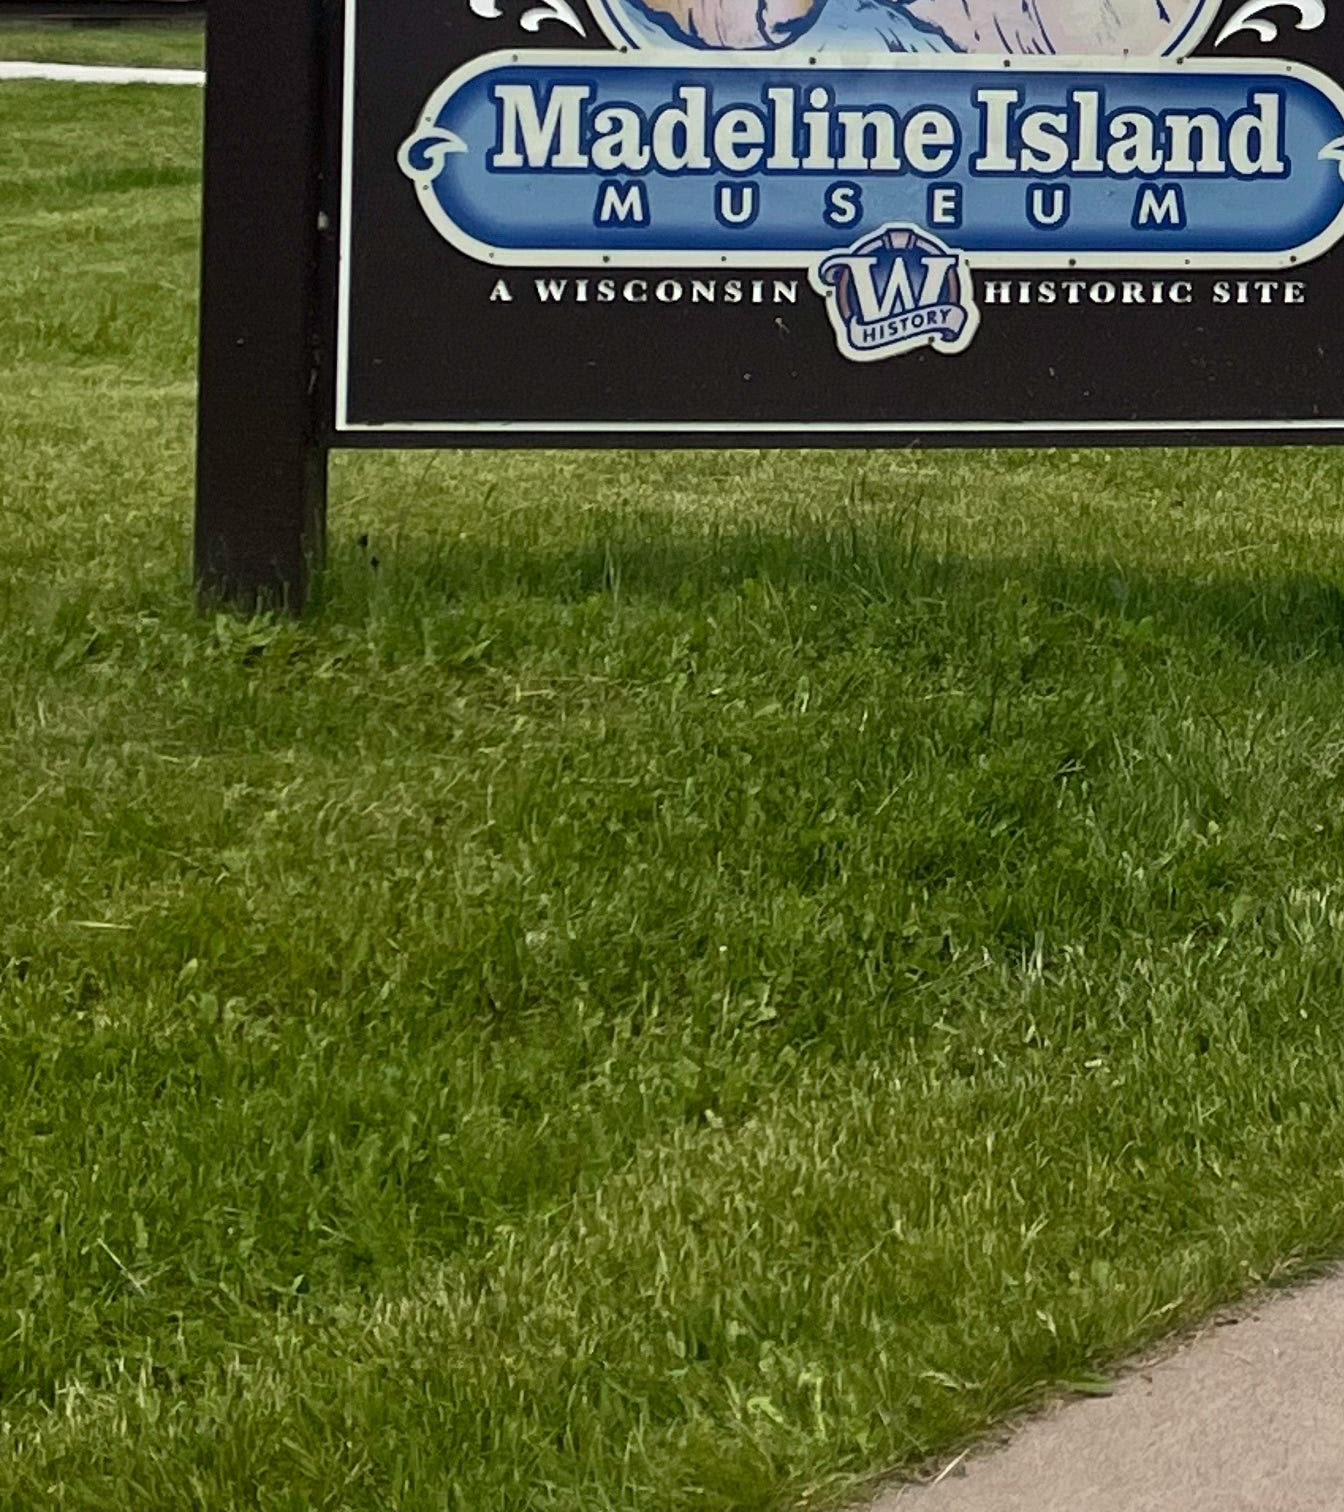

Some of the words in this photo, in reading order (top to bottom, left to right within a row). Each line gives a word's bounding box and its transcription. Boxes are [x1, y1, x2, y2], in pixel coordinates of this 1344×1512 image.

[492, 84, 955, 171] Madeline
[975, 89, 1285, 175] Island
[600, 185, 1180, 225] MUSEUM
[489, 279, 513, 302] A
[534, 279, 798, 303] WISCONSIN
[984, 280, 1193, 304] HISTORIC
[1213, 280, 1306, 304] SITE
[862, 307, 953, 343] HISTORY
